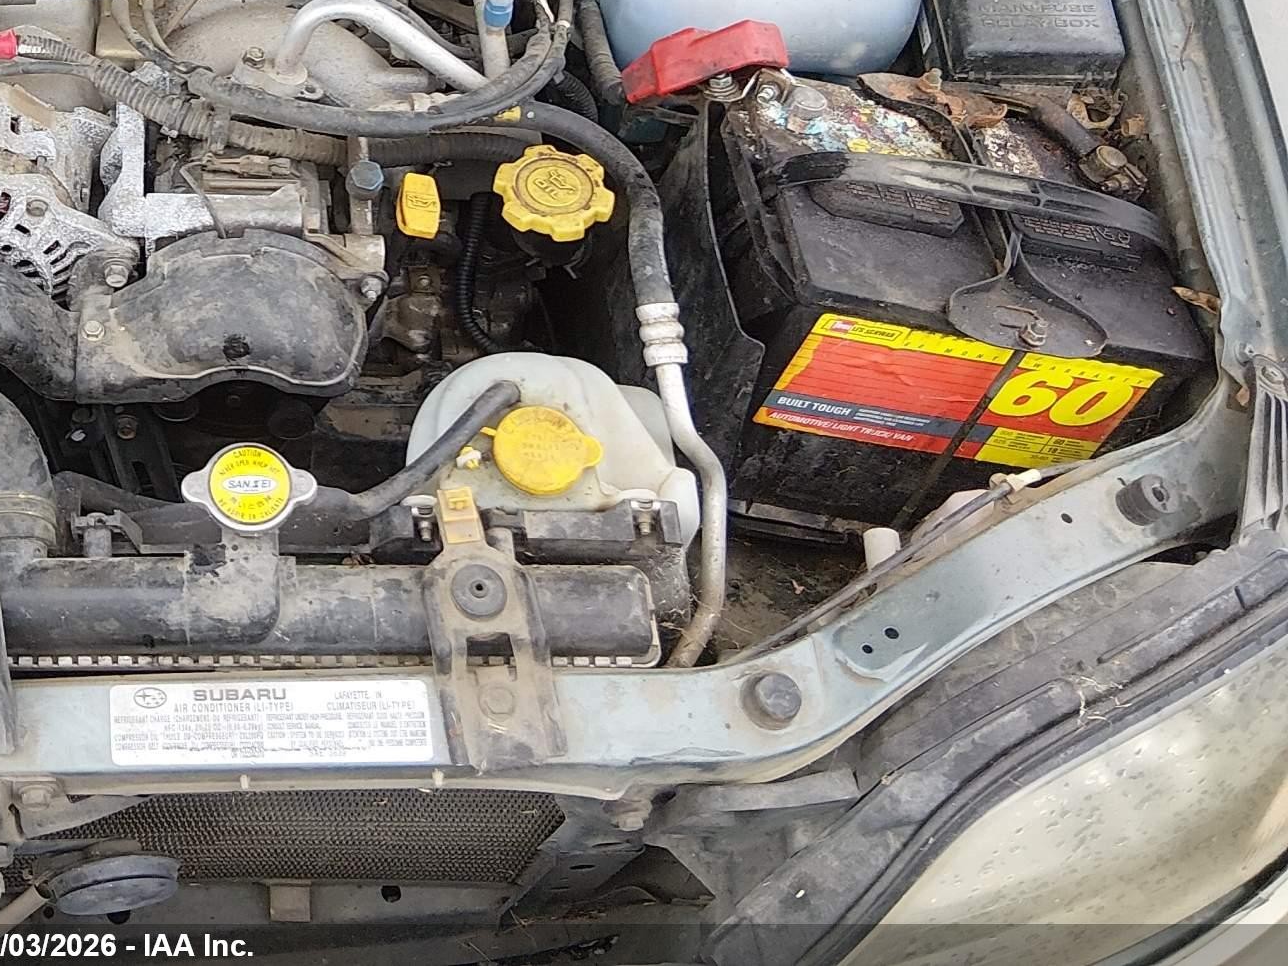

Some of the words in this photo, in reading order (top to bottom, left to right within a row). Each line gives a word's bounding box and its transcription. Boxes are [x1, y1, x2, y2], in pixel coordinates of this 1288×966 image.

[1041, 4, 1097, 13] FUSE
[1055, 19, 1100, 28] BOX
[988, 369, 1134, 427] 60
[777, 396, 812, 409] BUILT
[812, 401, 852, 416] TOUGH
[832, 422, 861, 433] LIGHT
[893, 432, 914, 442] VAN
[193, 688, 287, 701] SUBARU
[174, 704, 188, 713] AIR
[192, 703, 251, 713] CONDITIONER
[326, 700, 377, 711] CLIMATISEUR
